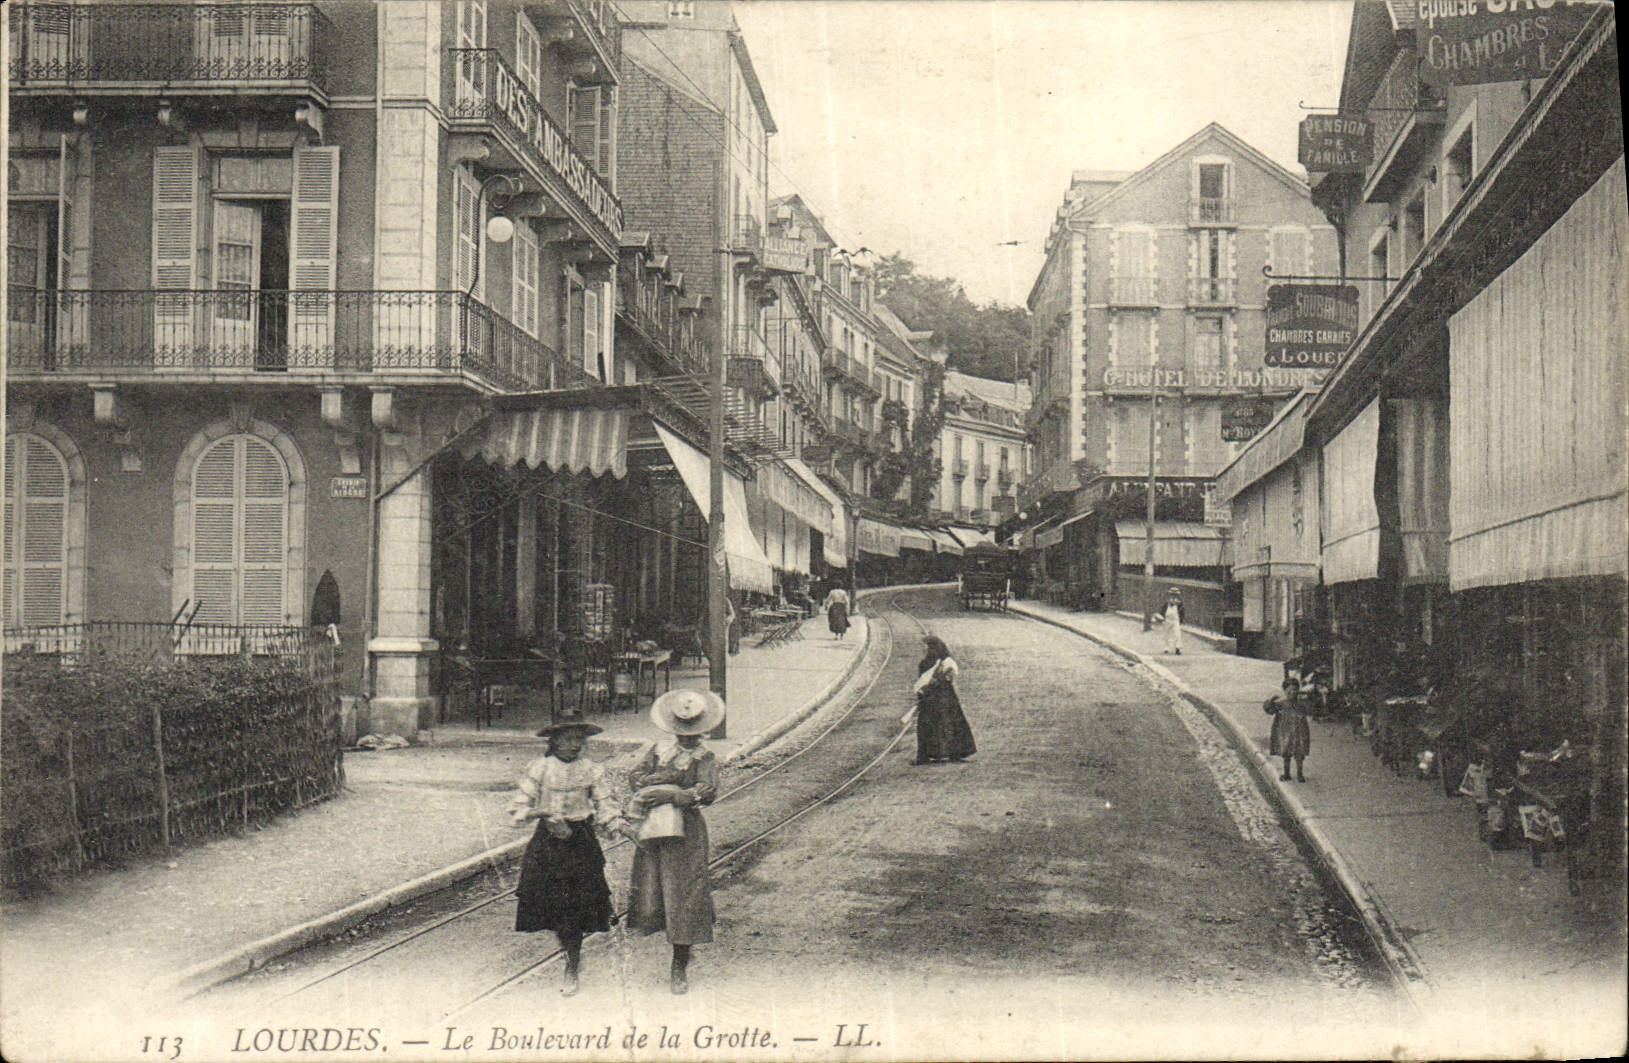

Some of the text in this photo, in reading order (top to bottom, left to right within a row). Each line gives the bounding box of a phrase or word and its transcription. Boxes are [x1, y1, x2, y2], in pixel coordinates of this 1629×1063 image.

[1427, 15, 1550, 70] CHAMBRES
[1304, 119, 1368, 138] PENSION
[495, 61, 623, 241] DES AMBASSADEURS
[1323, 138, 1345, 151] DE
[1306, 149, 1360, 165] FAMILLE
[1269, 329, 1313, 344] CHAMBRES
[1199, 370, 1227, 388] DE
[1236, 370, 1324, 389] LONDRES
